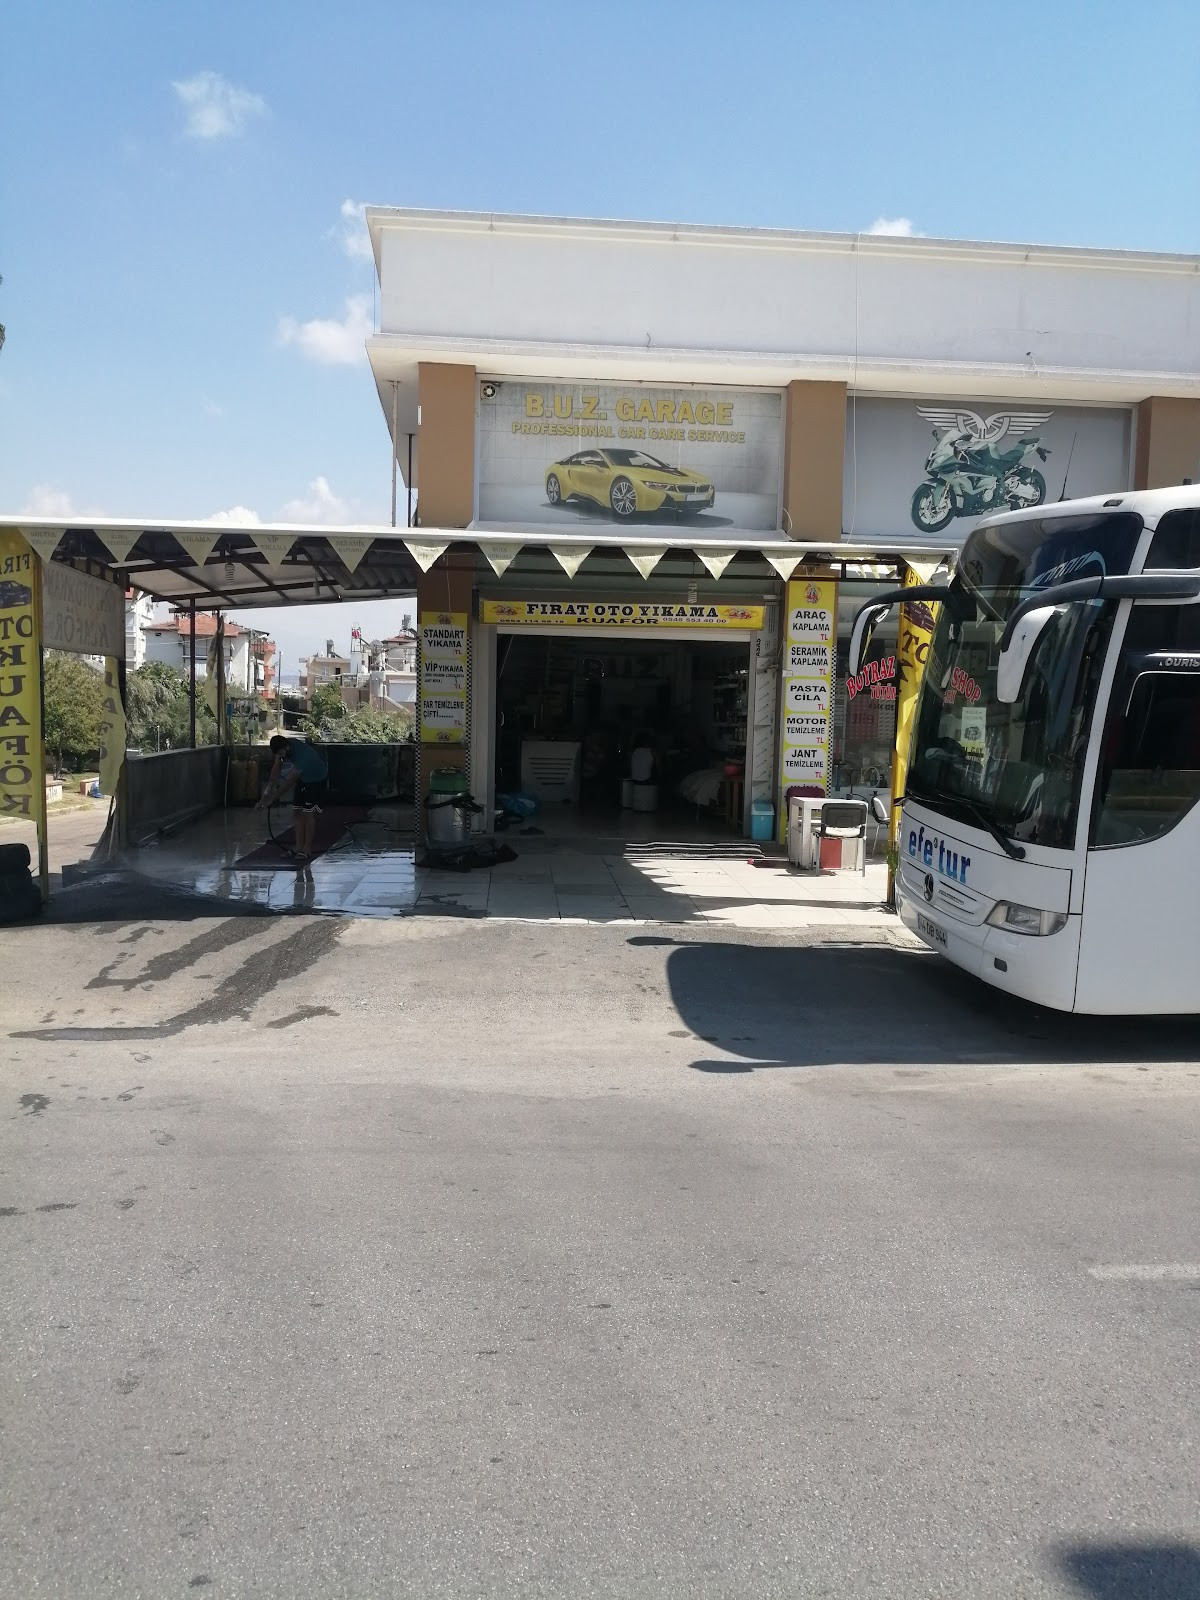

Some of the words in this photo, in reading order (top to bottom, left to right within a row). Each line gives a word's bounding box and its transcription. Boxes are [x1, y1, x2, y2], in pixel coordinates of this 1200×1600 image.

[526, 393, 607, 421] B.U.Z.
[615, 397, 734, 426] GARAGE
[511, 421, 615, 438] PROFESSIONAL
[618, 426, 647, 440] CAR
[649, 427, 685, 442] CARE
[688, 429, 746, 444] SERVICE
[526, 603, 589, 616] FIRAT
[594, 604, 634, 617] OTO
[640, 605, 719, 618] YIKAMA
[576, 616, 659, 625] KUAFÖR
[795, 610, 827, 622] ARAÇ
[792, 622, 830, 631] KAPLAMA
[423, 629, 465, 640] STANDART
[820, 633, 829, 641] TL
[427, 639, 462, 648] YIKAMA
[791, 645, 827, 656] SERAMİK
[791, 657, 829, 666] KAPLAMA
[424, 660, 438, 672] VİP
[438, 664, 464, 673] YIKAMA
[819, 668, 827, 676] TL
[790, 685, 827, 693] PASTA
[951, 666, 981, 705] SHOP
[794, 692, 821, 701] CİLA
[423, 700, 434, 709] FAR
[434, 700, 465, 709] TEMİZLEME
[817, 703, 825, 711] TL
[786, 717, 827, 725] MOTOR
[786, 725, 825, 735] TEMİZLEME
[791, 750, 818, 758] JANT
[785, 758, 824, 768] TEMİZLEME
